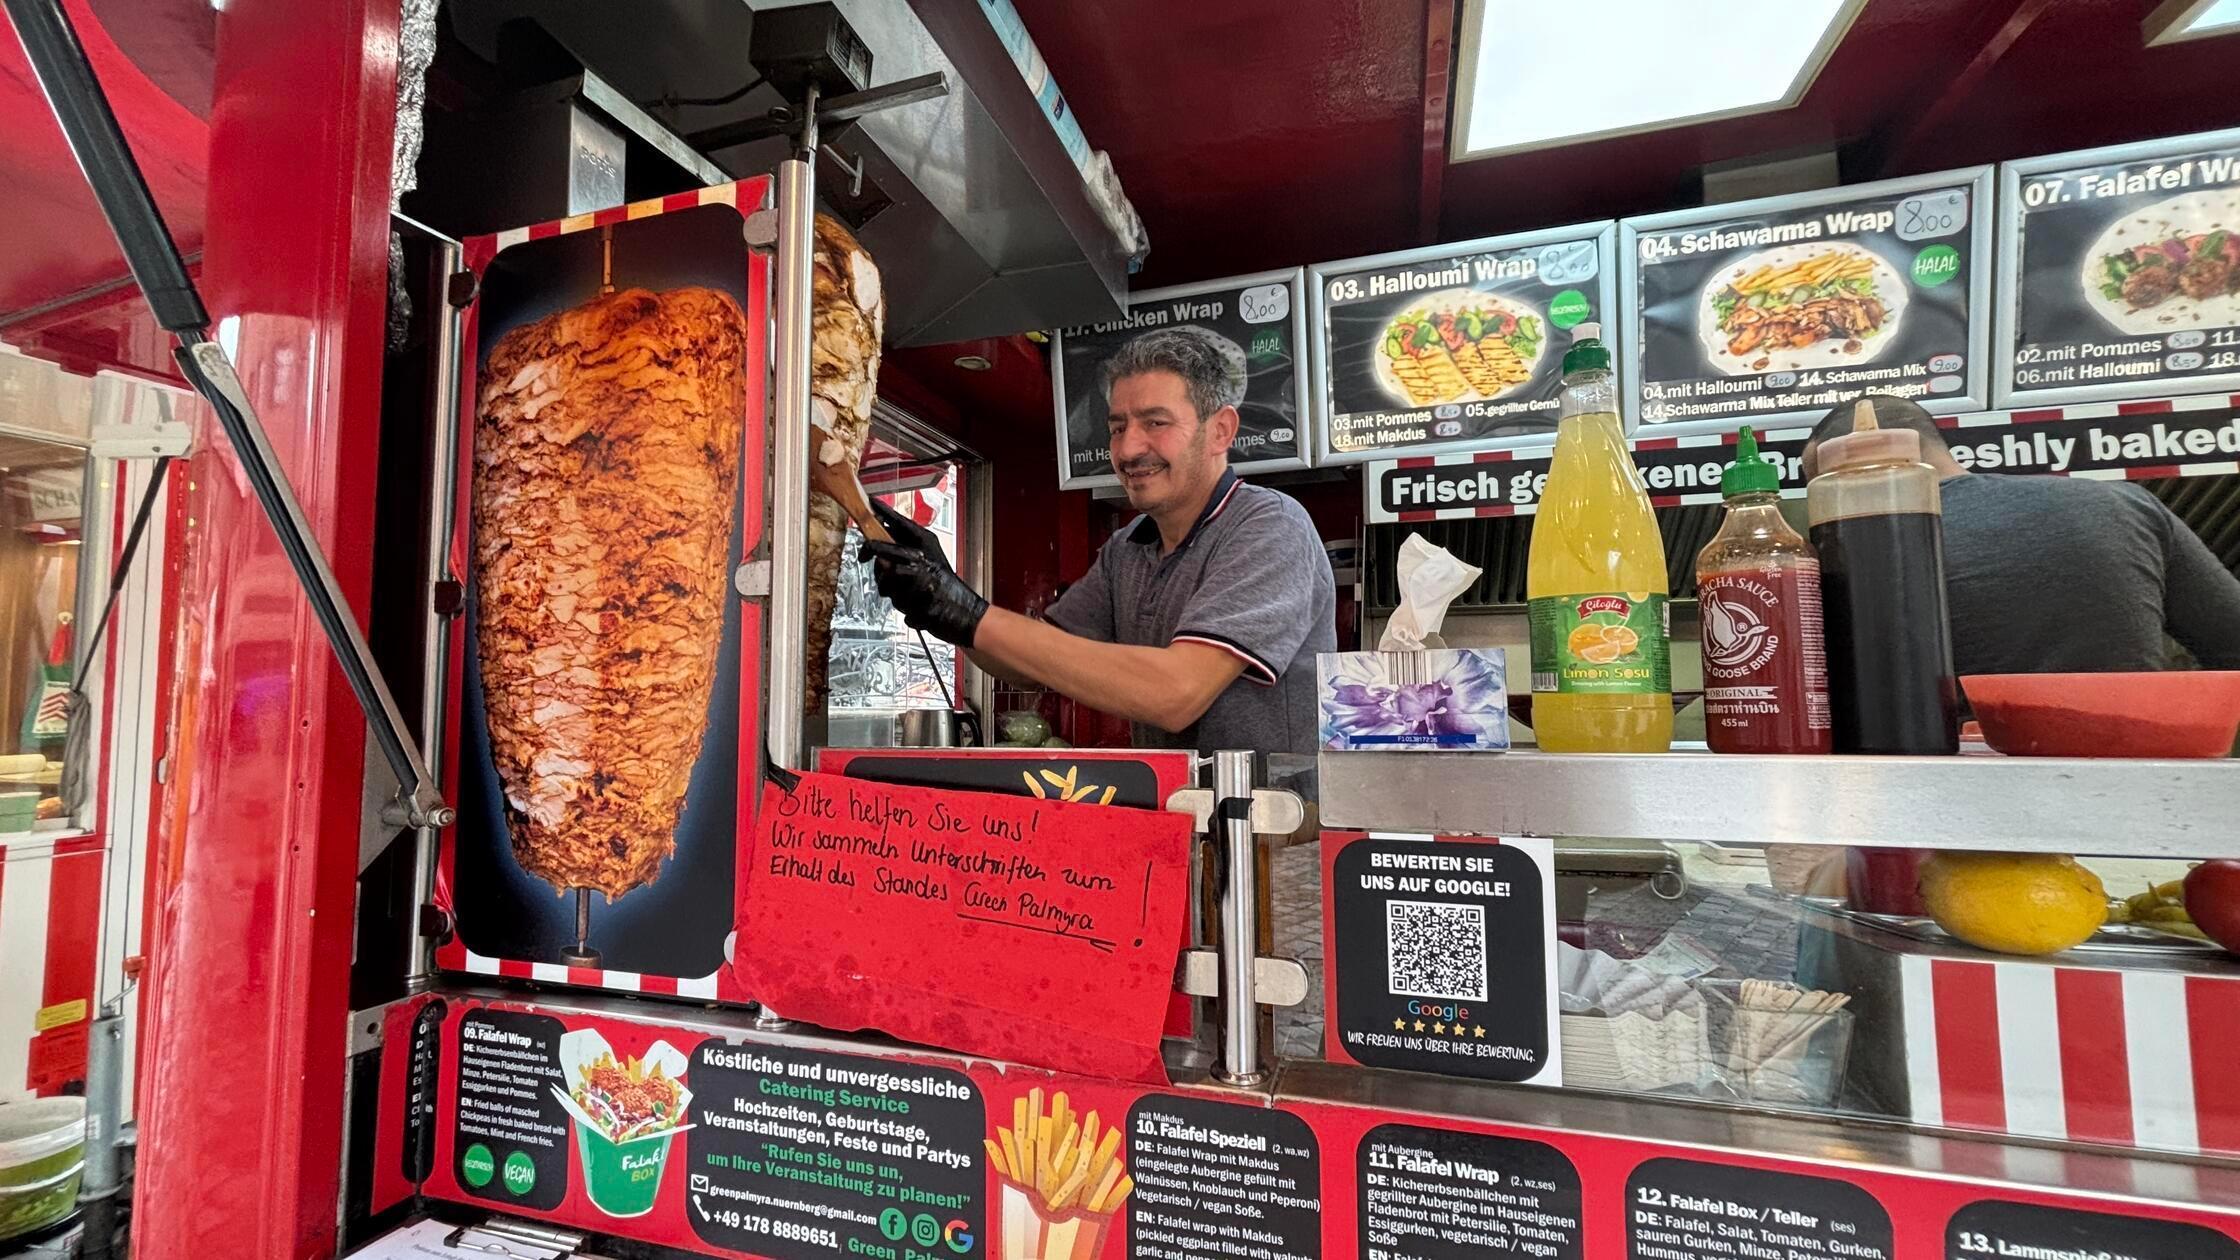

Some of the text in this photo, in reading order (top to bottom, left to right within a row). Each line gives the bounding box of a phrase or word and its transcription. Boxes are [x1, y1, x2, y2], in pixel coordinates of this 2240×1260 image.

[2025, 180, 2070, 207] 07.
[2080, 162, 2192, 199] Falafel
[1641, 210, 1893, 258] 04. Schawarma Wrap
[1331, 257, 1536, 301] 03. Halloumi Wrap
[1915, 254, 1955, 274] HALAL
[1173, 301, 1223, 321] Wrap
[1253, 338, 1280, 353] HALAL
[2081, 339, 2162, 358] Pommes
[1695, 377, 1762, 395] Halloumi
[1826, 367, 1900, 384] Schawarma
[1903, 364, 1927, 376] Mix
[2079, 358, 2160, 379] Halloumi
[1376, 410, 1432, 426] Pommes
[1530, 398, 1560, 410] Gemü
[1750, 396, 1775, 409] Mix
[1775, 393, 1812, 408] Teller
[1814, 391, 1837, 404] mit
[1377, 427, 1426, 443] Makdus
[1949, 419, 2240, 472] eshly baked
[1074, 450, 1094, 463] mit
[1392, 471, 1499, 505] Frisch
[1699, 576, 1779, 607] RACHA SAUCE
[1712, 635, 1778, 678] GOOSE BRAND
[1564, 668, 1650, 678] Limon Sosu
[1710, 688, 1761, 698] ORIGINAL
[1721, 719, 1737, 727] 455
[778, 785, 1039, 844] Bitte helfen Sie uns!
[772, 821, 1115, 891] Wir sammeln Unterschriften zum
[1371, 853, 1493, 872] BEWERTEN SIE
[771, 854, 823, 883] Erhalt
[828, 858, 854, 886] des
[874, 868, 948, 901] Standes
[1019, 893, 1094, 933] Palmyra
[1361, 875, 1510, 896] UNS AUF GOOGLE!
[1408, 1000, 1469, 1021] Google
[464, 1027, 531, 1048] 09. Falafel Wrap
[1348, 1031, 1535, 1062] WIR FREUEN UNS ÜBER IHRE BEWERTUNG.
[703, 1048, 971, 1100] Köstliche und unvergessliche
[474, 1100, 539, 1118] Fried masched
[759, 1079, 909, 1114] Catering Service
[735, 1098, 930, 1143] Hochzeiten, Geburtstage,
[1139, 1112, 1184, 1125] mit Makdus
[518, 1133, 537, 1144] French
[705, 1111, 971, 1168] Veranstaltungen, Feste und Partys
[1137, 1120, 1266, 1151] 10. Falafel Speziell
[1372, 1143, 1433, 1159] mit Aubergine
[505, 1163, 534, 1183] VEGAN
[817, 1156, 841, 1169] Sie
[846, 1159, 874, 1174] uns
[879, 1165, 903, 1182] un,
[1136, 1156, 1296, 1190] (eingelegte Aubergine gefüllt mit
[1157, 1144, 1279, 1171] Falafel Wrap mit Makdus
[1369, 1152, 1499, 1185] 11. Falafel Wrap
[707, 1152, 728, 1167] um
[733, 1153, 761, 1173] Ihre
[765, 1160, 873, 1196] Veranstaltung
[877, 1183, 896, 1198] zu
[1136, 1172, 1320, 1212] Walnüssen, Knoblauch und Peperoni)
[1393, 1176, 1539, 1208] Kichererbsenbällchen mit
[1368, 1189, 1576, 1229] gegrillter Aubergine im Hauseigenen
[1637, 1187, 1856, 1235] 12. Falafel Box Teller (ses)
[713, 1210, 837, 1248] +49 178 8889651
[1666, 1215, 1714, 1236] Falafel,
[1761, 1229, 1825, 1251] Tomaten,
[1830, 1240, 1885, 1260] Gurken,
[1959, 1231, 1994, 1253] 13.
[848, 1237, 896, 1260] Green
